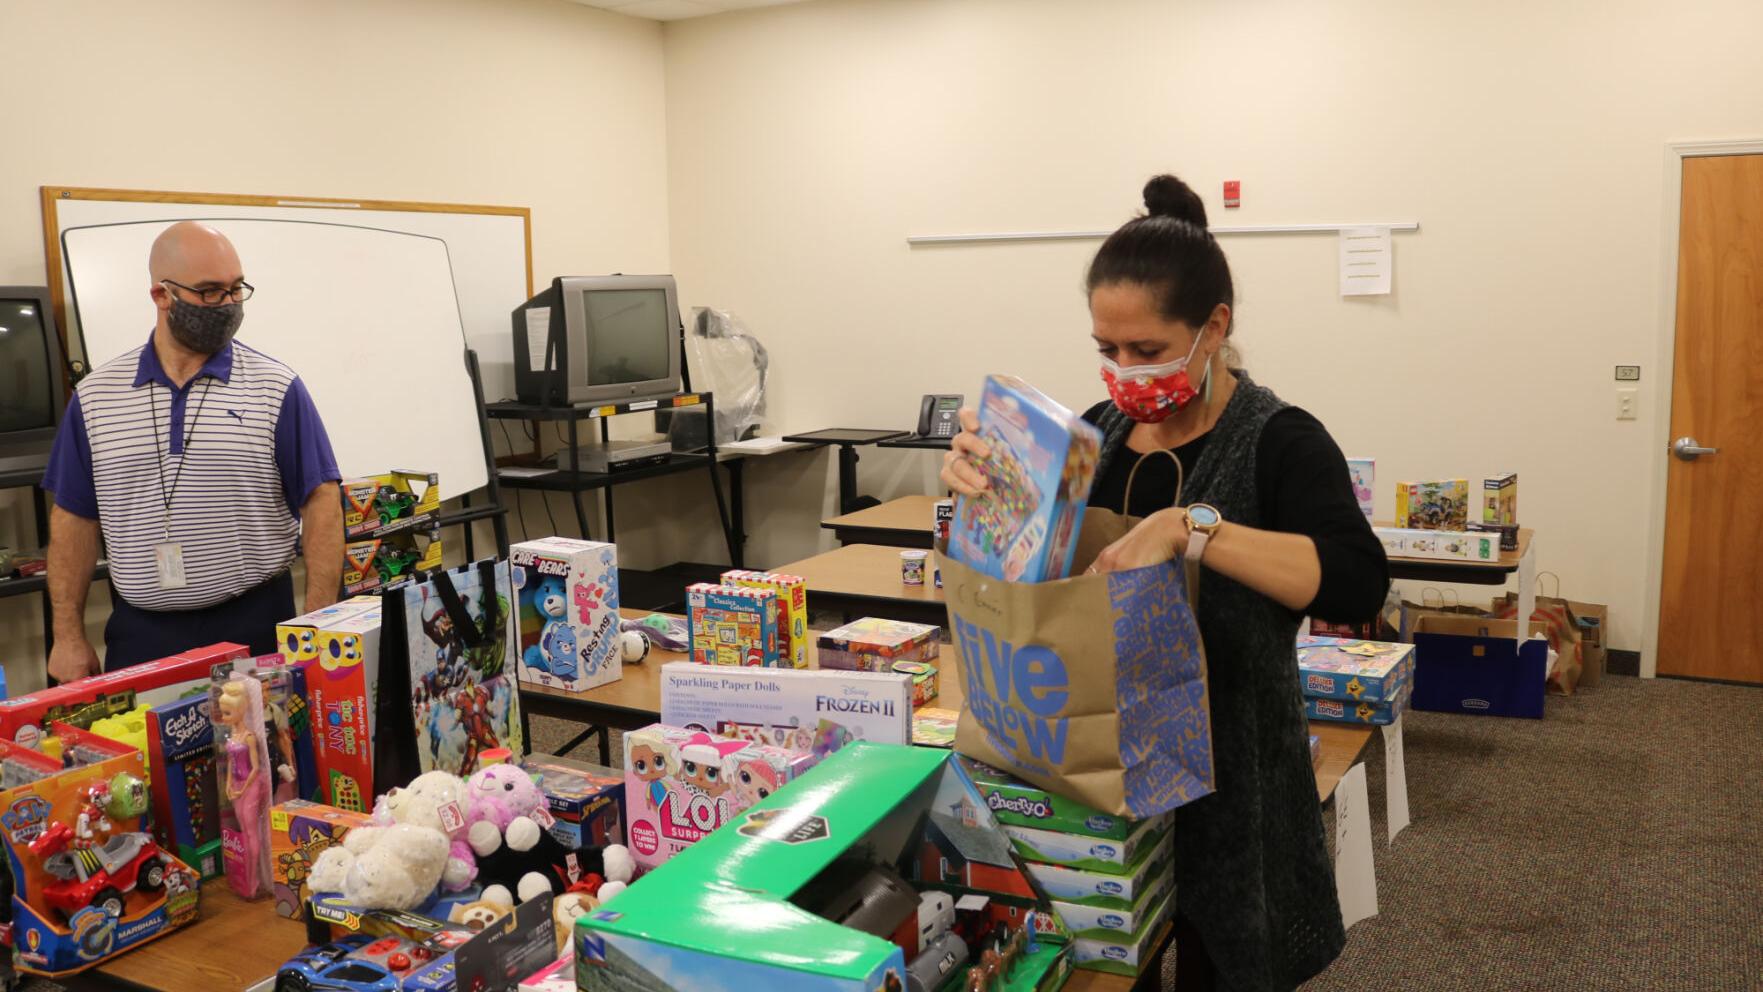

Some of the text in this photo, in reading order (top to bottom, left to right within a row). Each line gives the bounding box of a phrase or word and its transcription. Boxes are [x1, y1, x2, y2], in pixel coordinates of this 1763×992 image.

[512, 551, 537, 566] CARE
[538, 560, 571, 577] BEARS
[713, 598, 736, 606] Classics
[729, 604, 755, 612] Collection
[580, 615, 611, 663] Resting
[601, 645, 619, 670] FACE
[669, 676, 781, 692] Sparkling Paper Dolls
[1308, 683, 1334, 693] EDITION
[816, 695, 896, 717] FROZEN II
[165, 706, 197, 736] Etch A
[175, 717, 206, 746] Sketch
[1, 801, 52, 830] PAW
[793, 820, 823, 840] LIFE
[316, 905, 330, 915] TRY
[117, 916, 163, 940] MARSHALL
